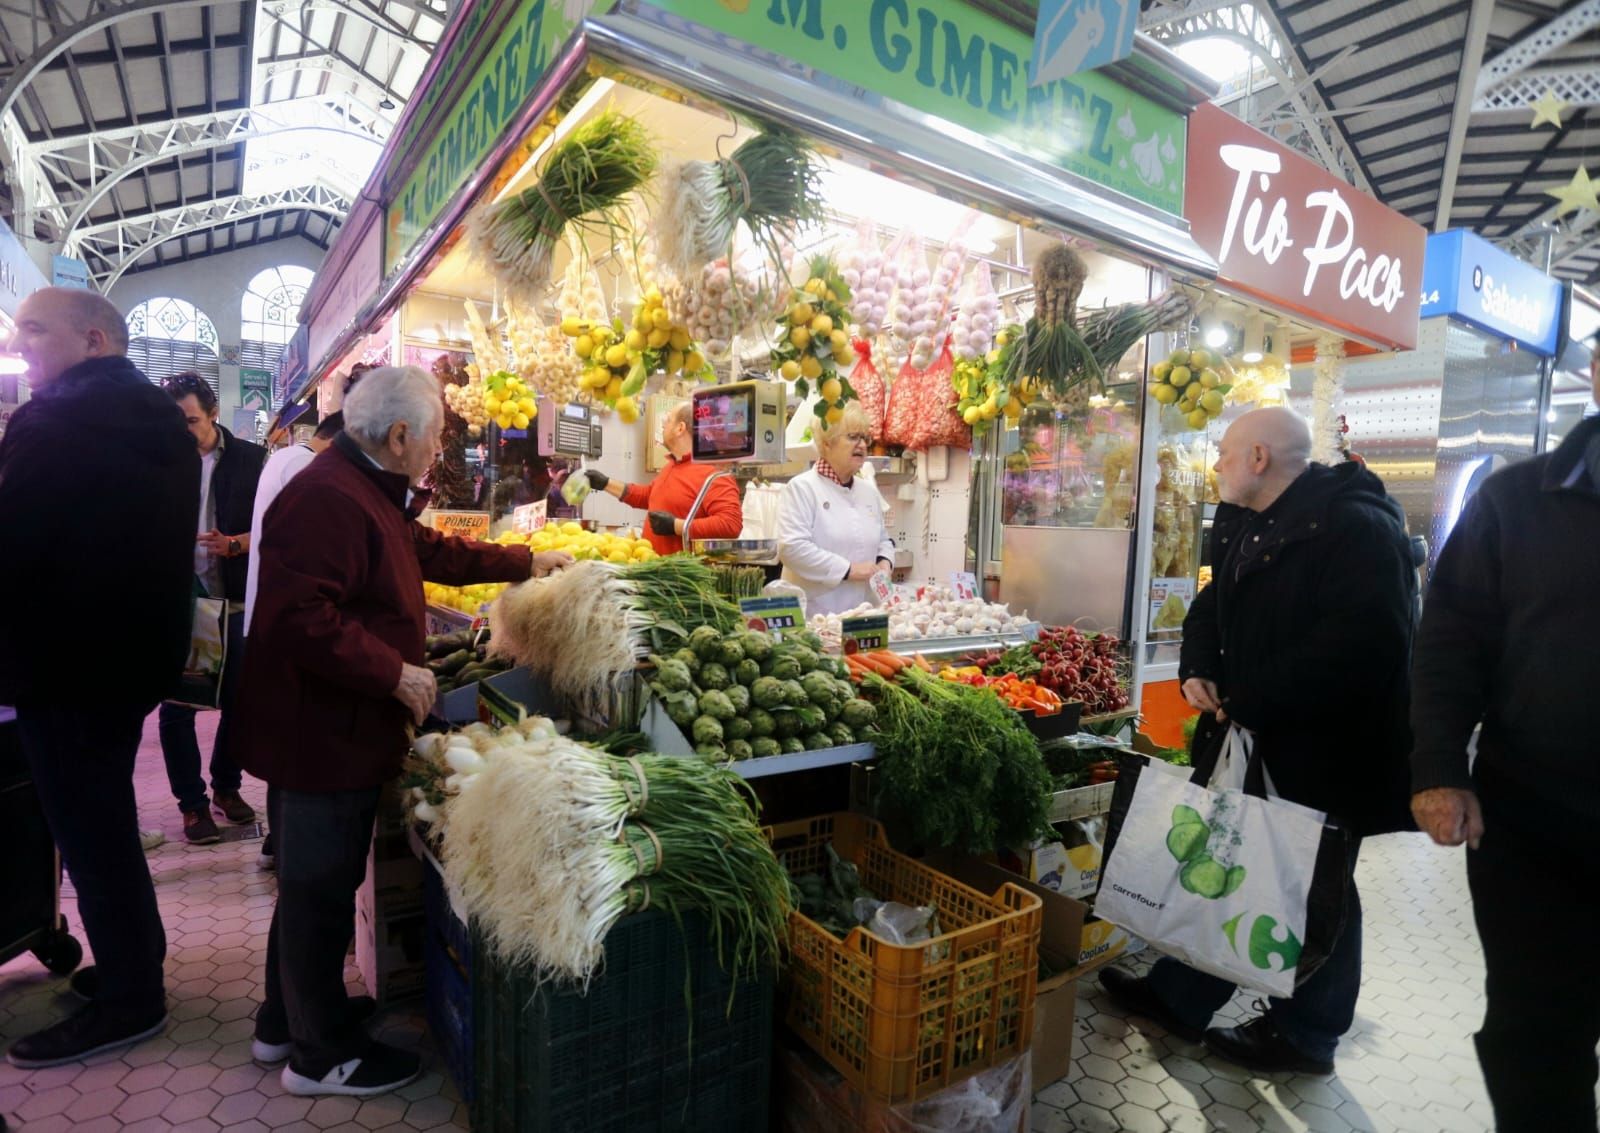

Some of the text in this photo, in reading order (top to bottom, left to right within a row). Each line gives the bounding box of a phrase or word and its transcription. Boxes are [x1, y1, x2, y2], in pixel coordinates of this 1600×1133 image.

[424, 0, 546, 216] GIMENEZ
[869, 0, 1113, 167] GIMENEZ
[1303, 188, 1404, 312] Paco
[444, 516, 483, 528] POMELO
[1080, 942, 1110, 961] Coplaca
